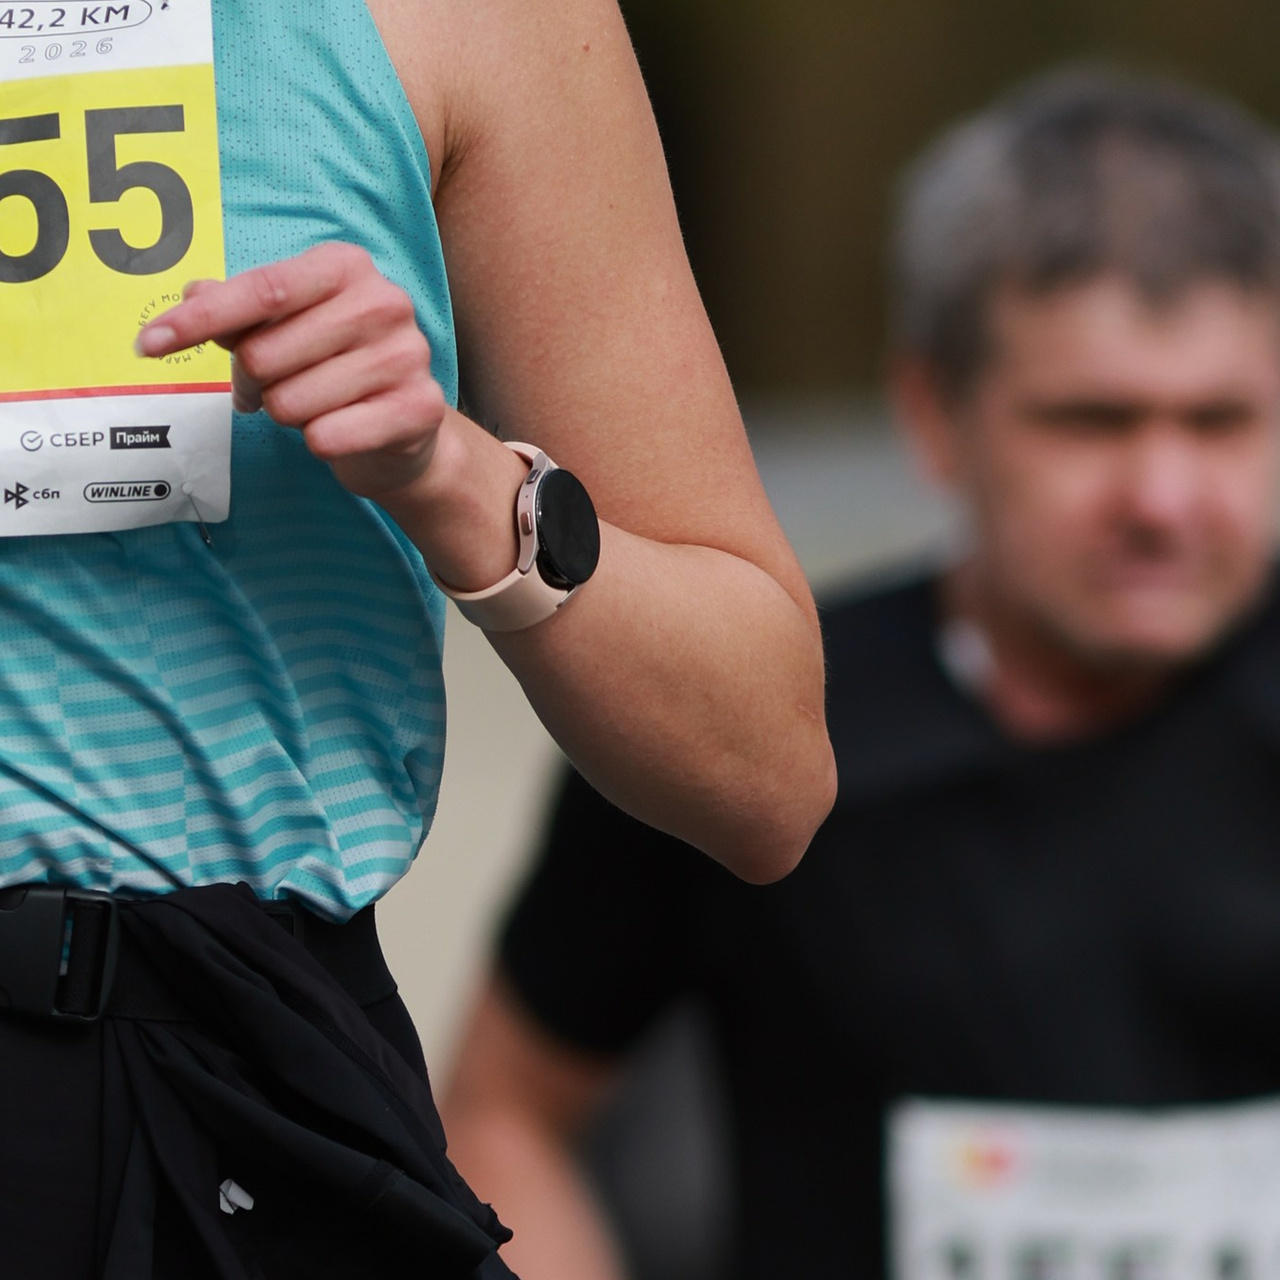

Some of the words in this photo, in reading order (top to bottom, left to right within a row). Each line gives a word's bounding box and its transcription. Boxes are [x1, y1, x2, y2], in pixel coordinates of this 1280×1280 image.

[80, 4, 131, 26] КМ
[18, 37, 114, 64] 2026
[50, 431, 105, 448] СБЕР
[116, 431, 161, 446] Прайм
[33, 488, 60, 500] сбп
[90, 485, 152, 498] WINLINE
